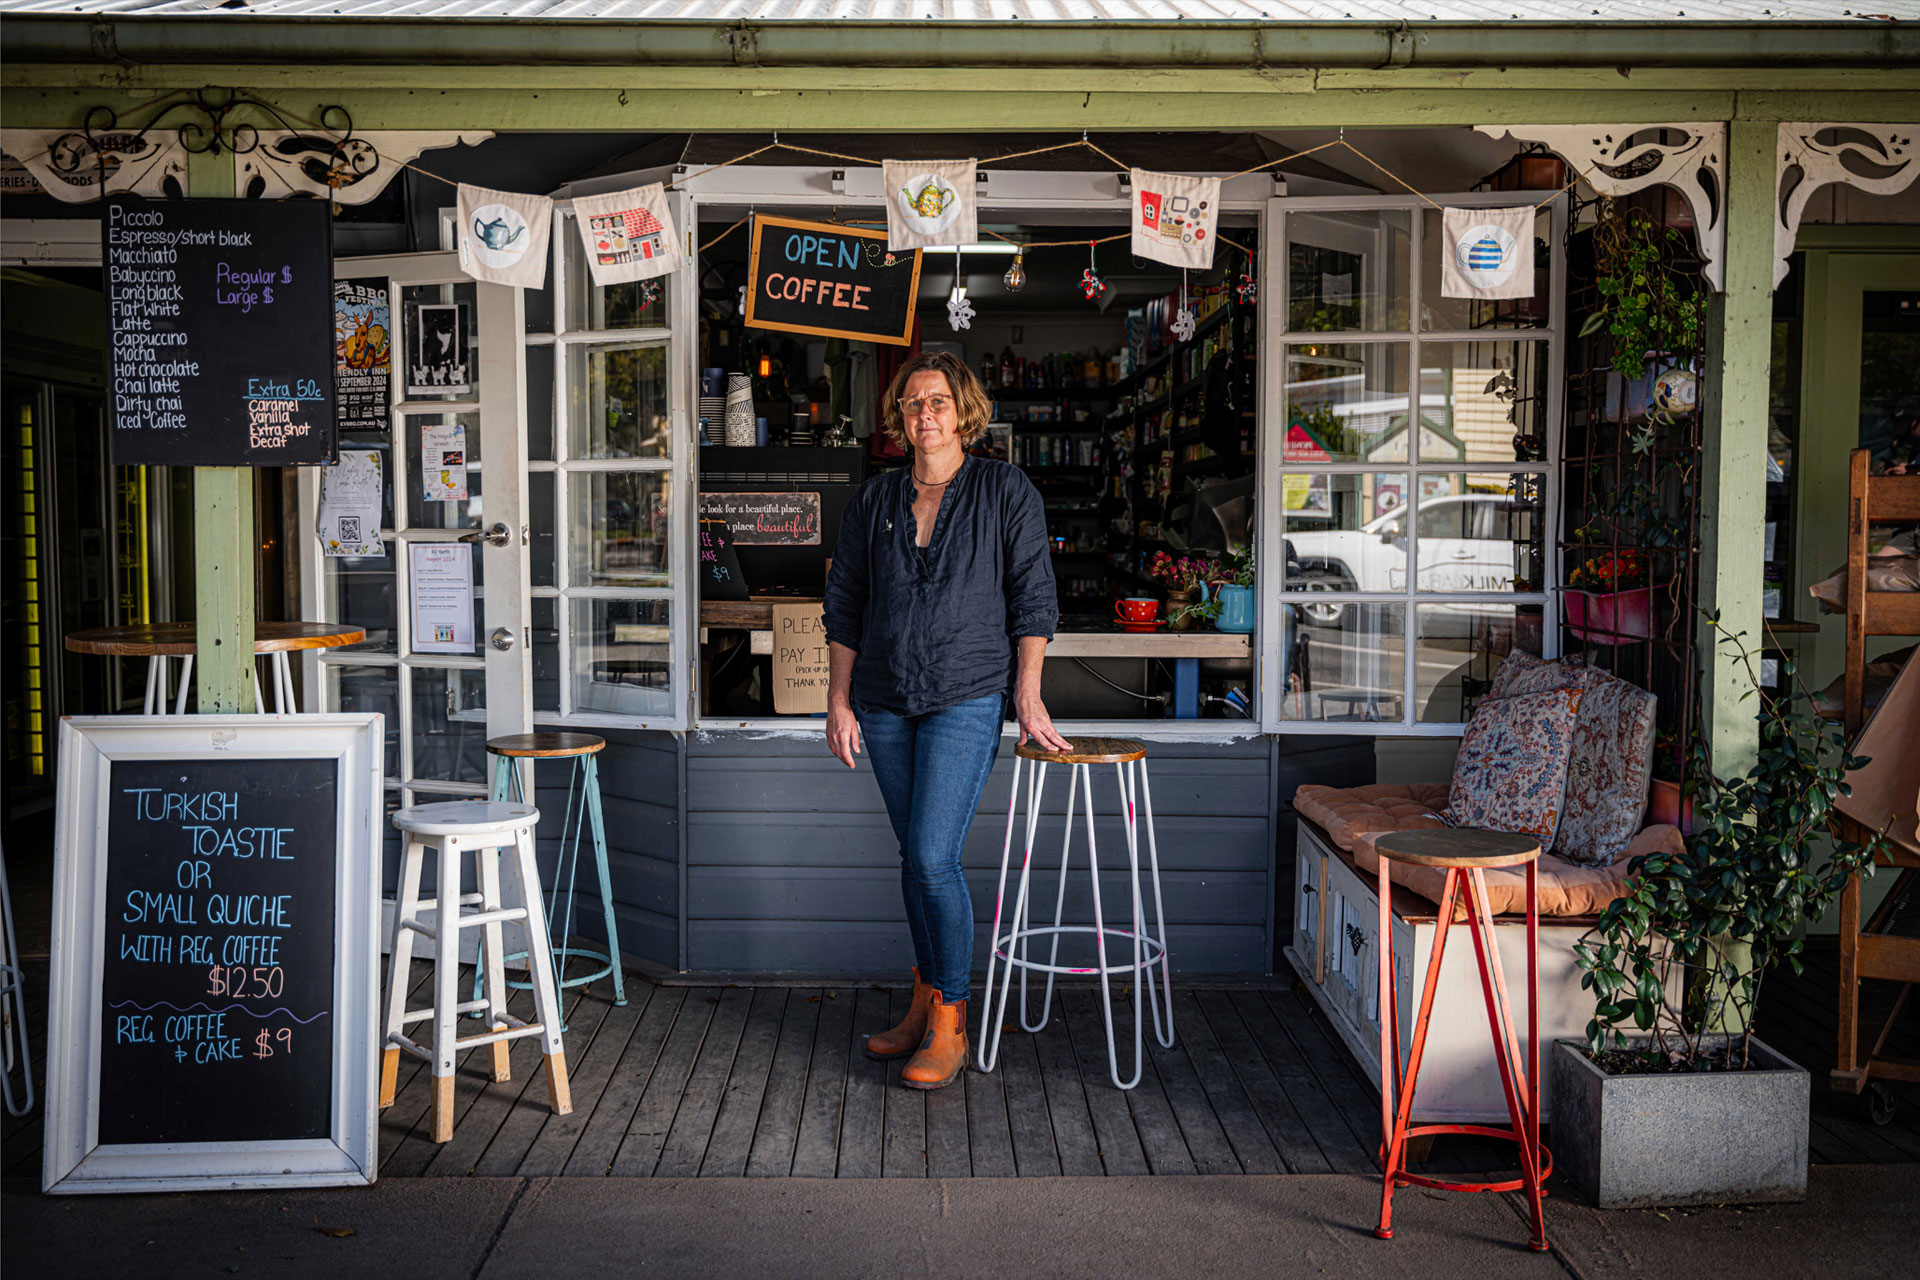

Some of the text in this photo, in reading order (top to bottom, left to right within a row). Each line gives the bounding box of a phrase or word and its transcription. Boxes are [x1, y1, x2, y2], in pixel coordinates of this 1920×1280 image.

[110, 205, 164, 226] Piccolo
[109, 228, 253, 248] Espresso/short black
[110, 247, 177, 264] Macchiato
[785, 234, 860, 270] OPEN
[110, 266, 176, 287] Babyccino
[217, 262, 292, 292] Regular $
[111, 285, 184, 305] Long black
[217, 287, 274, 313] Large $
[355, 284, 387, 300] BBQ
[765, 272, 872, 311] COFFEE
[112, 302, 143, 317] Flat
[113, 317, 152, 331] Latte
[113, 332, 188, 349] Cappuccino
[114, 347, 156, 362] Mocha
[115, 361, 200, 377] Hot chocolate
[339, 367, 387, 377] IENDLY INN
[115, 378, 181, 394] Chai latte
[248, 378, 322, 397] Extra 50c
[340, 376, 372, 387] SEPTEMBER
[372, 375, 387, 386] 2024
[116, 395, 182, 418] Dirty chai
[249, 399, 298, 412] Caramel
[117, 412, 187, 429] Iced Coffee
[250, 423, 311, 437] Extra shot
[250, 435, 287, 449] Decaf
[707, 504, 723, 513] look
[725, 504, 736, 513] for
[746, 504, 779, 513] beautiful
[732, 522, 754, 533] place
[700, 550, 718, 561] AKE
[712, 565, 731, 582] $9
[783, 617, 826, 634] PLEA
[780, 647, 806, 664] PAY
[784, 677, 816, 688] THANK
[123, 787, 238, 821] TURKISH
[182, 825, 295, 860] TOASTIE
[177, 860, 212, 889] OR
[123, 890, 292, 928] SMALL QUICHE
[121, 933, 283, 966] WITH REG COFFEE
[206, 964, 284, 999] $12.50
[117, 1013, 228, 1044] REG COFFEE
[195, 1038, 243, 1064] CAKE
